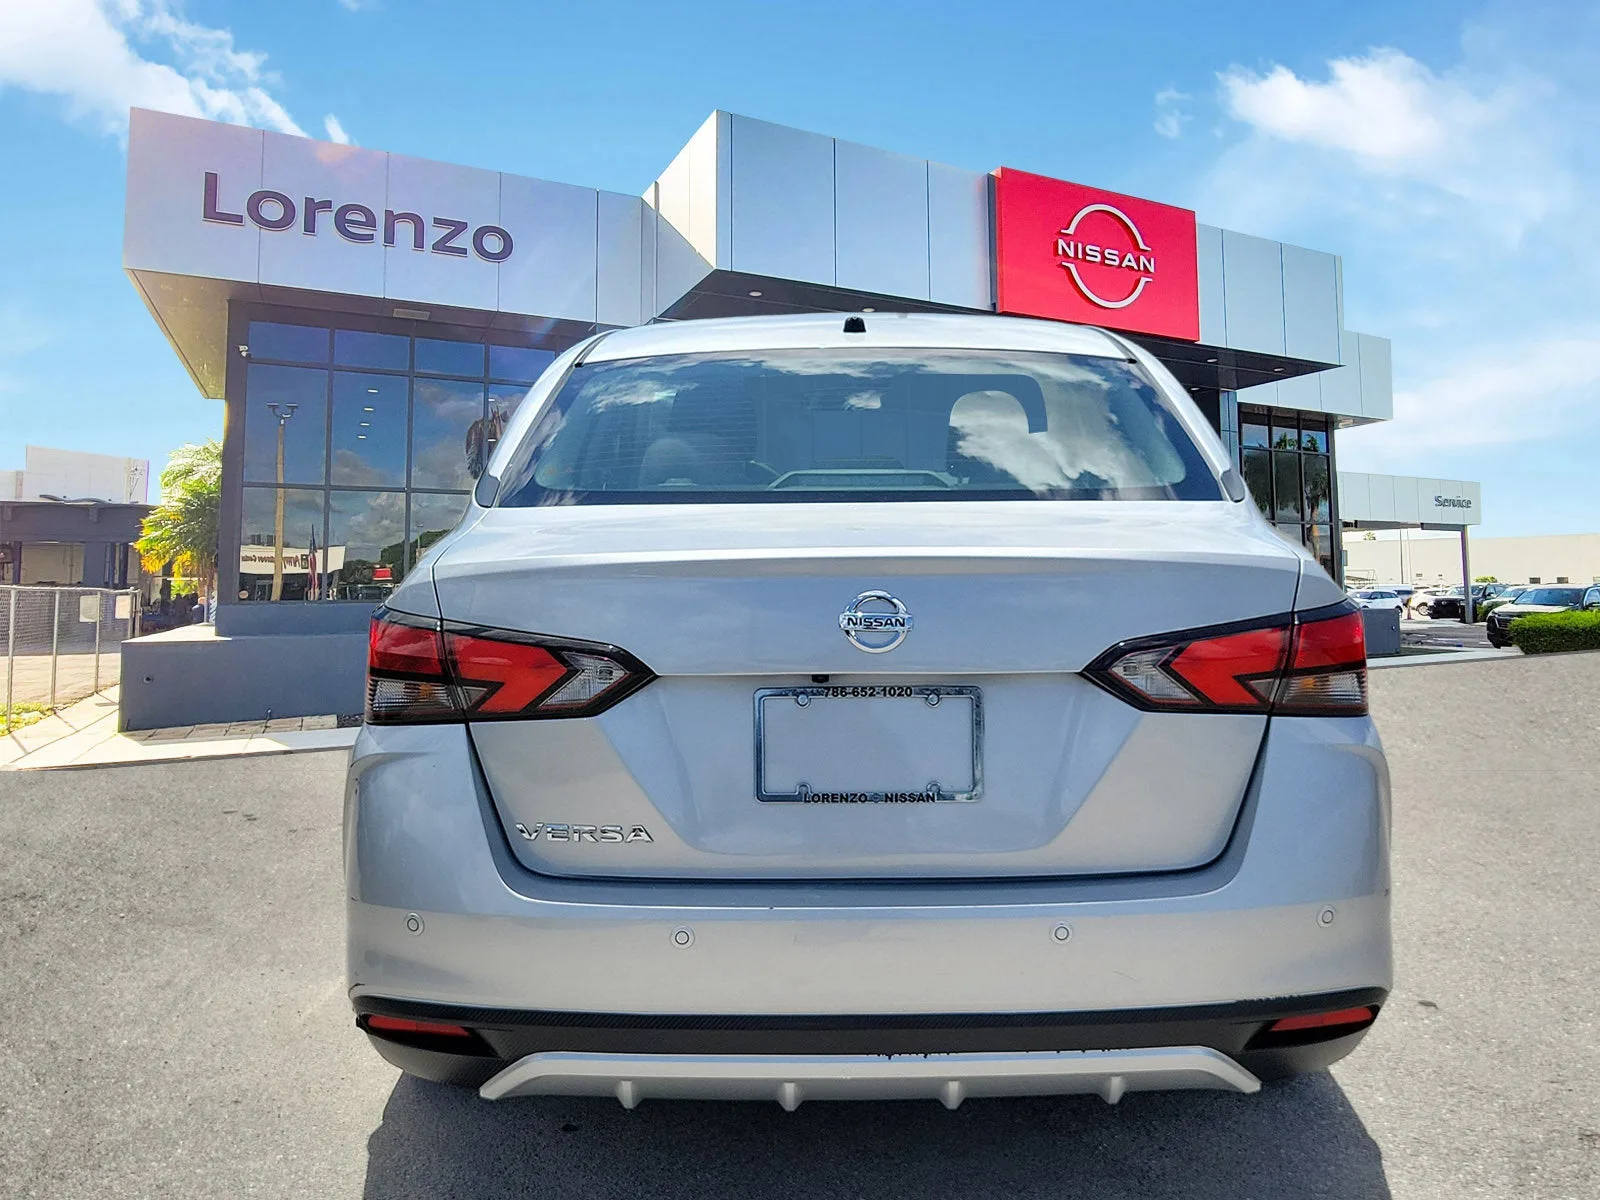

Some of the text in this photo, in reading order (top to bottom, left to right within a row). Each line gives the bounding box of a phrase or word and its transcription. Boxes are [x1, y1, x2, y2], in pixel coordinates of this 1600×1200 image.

[202, 171, 515, 262] Lorenzo
[1057, 238, 1155, 273] NISSAN
[1434, 495, 1472, 508] Service
[846, 616, 906, 629] NISSAN
[824, 686, 913, 698] 786-652-1020
[803, 792, 936, 804] LORENZO NISSAN
[515, 823, 654, 843] VERSA
